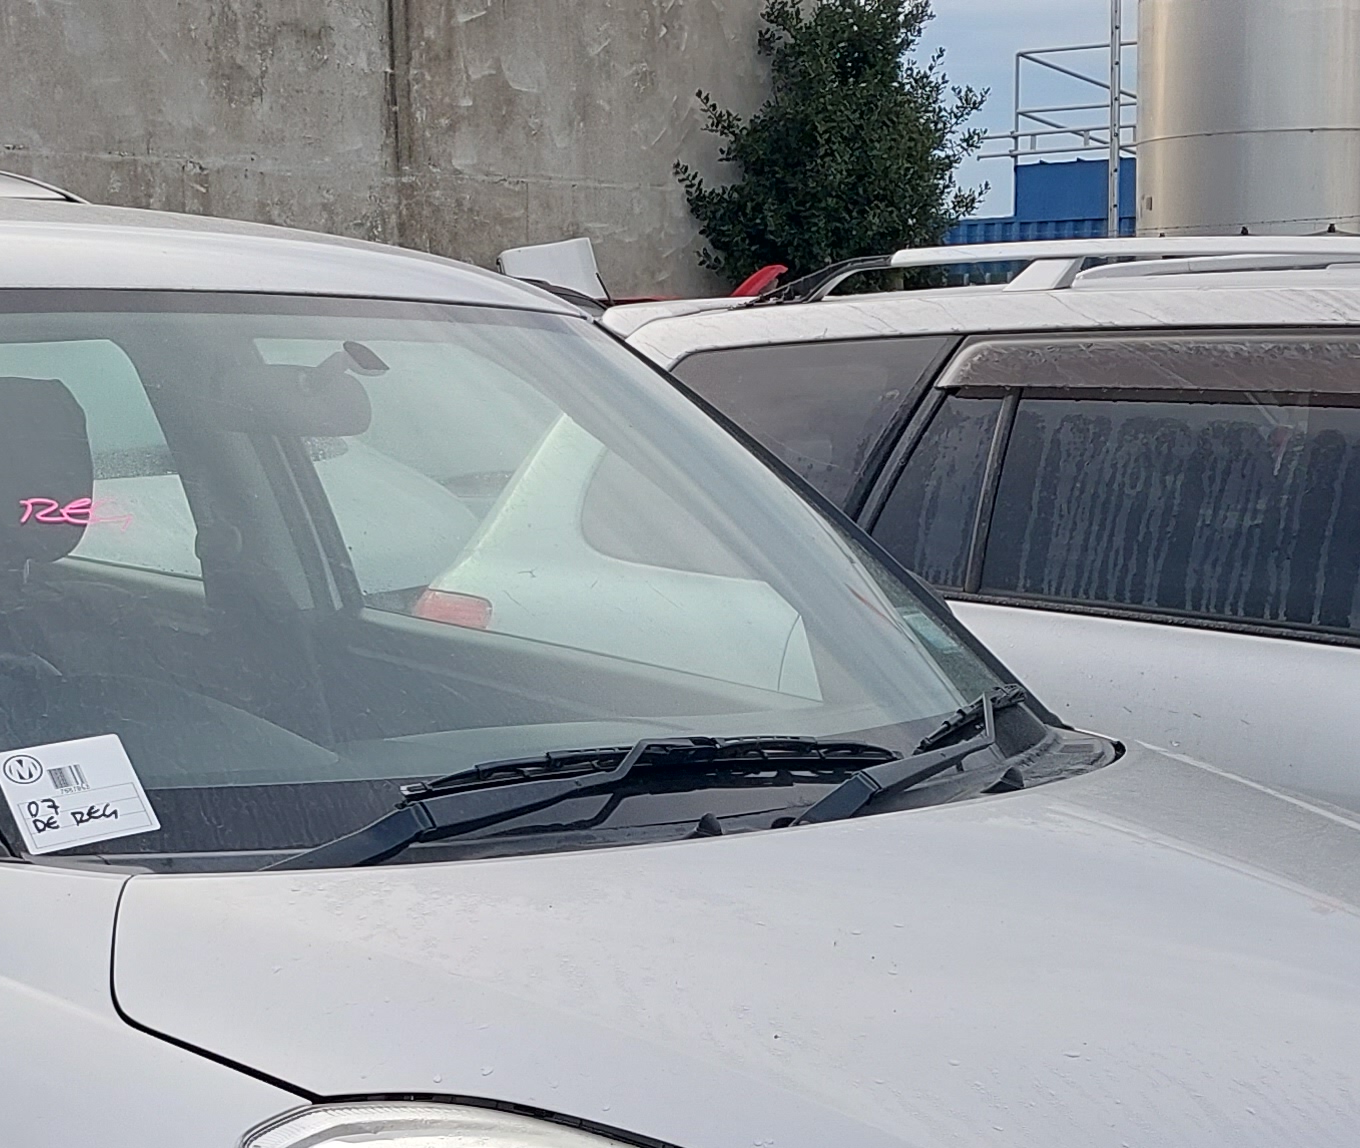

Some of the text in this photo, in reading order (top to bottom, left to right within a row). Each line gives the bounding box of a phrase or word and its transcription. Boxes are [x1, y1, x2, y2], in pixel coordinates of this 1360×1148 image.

[27, 798, 60, 818] 07
[32, 803, 119, 833] DE REG
